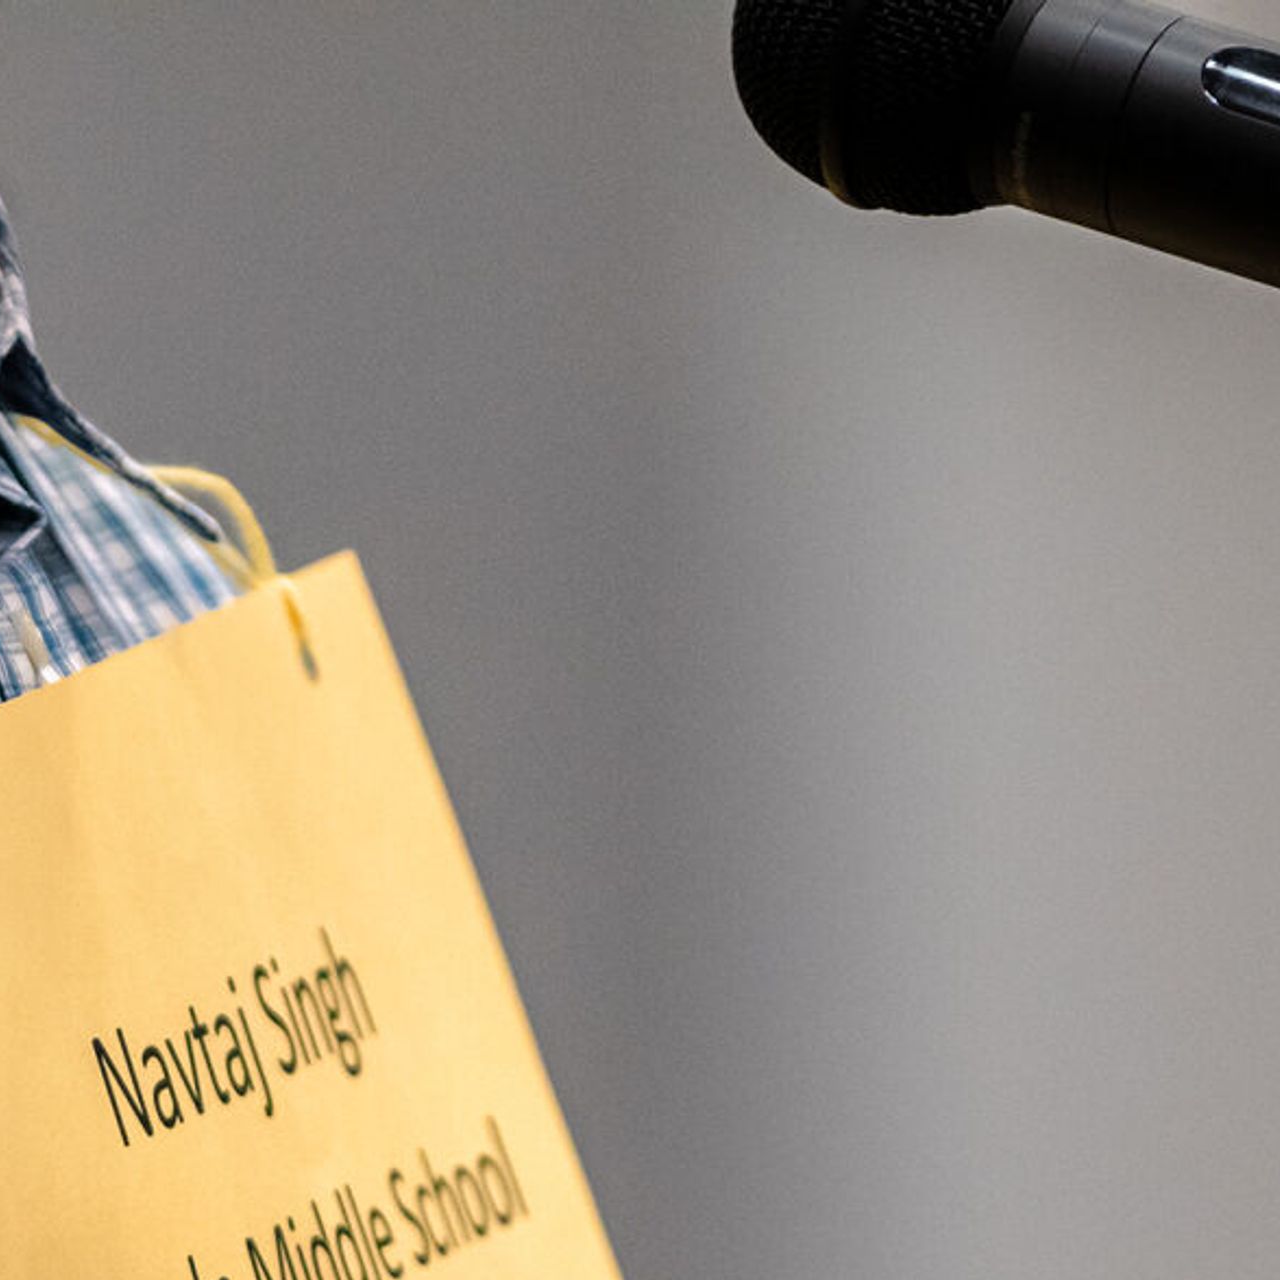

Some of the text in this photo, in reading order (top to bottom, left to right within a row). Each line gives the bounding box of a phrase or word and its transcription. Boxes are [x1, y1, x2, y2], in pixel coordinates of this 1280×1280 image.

[91, 926, 378, 1146] Navtaj Singh
[389, 1114, 530, 1265] School
